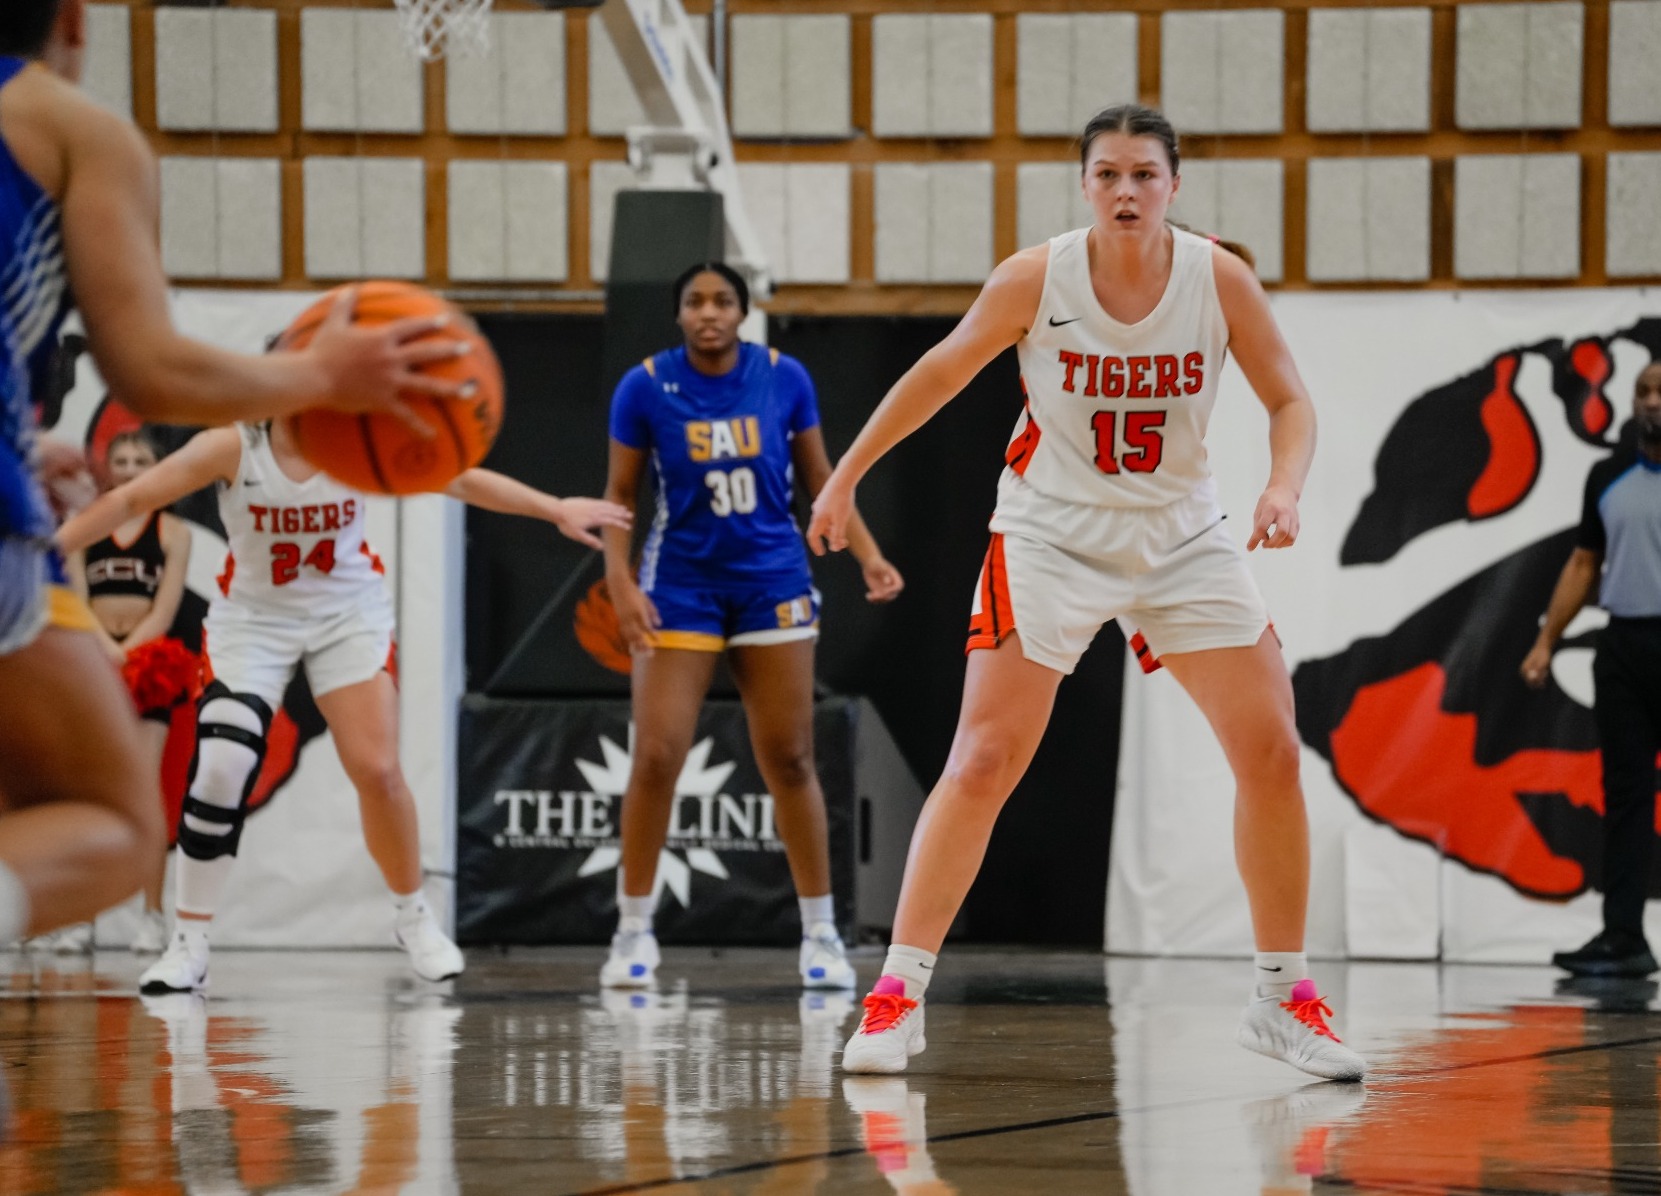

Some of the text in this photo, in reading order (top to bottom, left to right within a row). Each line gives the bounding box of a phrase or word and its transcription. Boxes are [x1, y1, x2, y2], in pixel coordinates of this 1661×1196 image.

[1058, 349, 1204, 398] TIGERS
[685, 415, 761, 462] SAU
[1091, 410, 1167, 474] 15
[248, 498, 356, 534] TIGERS
[705, 467, 757, 517] 30
[270, 538, 336, 586] 24
[775, 595, 813, 628] SAU
[494, 789, 776, 839] THE LINI
